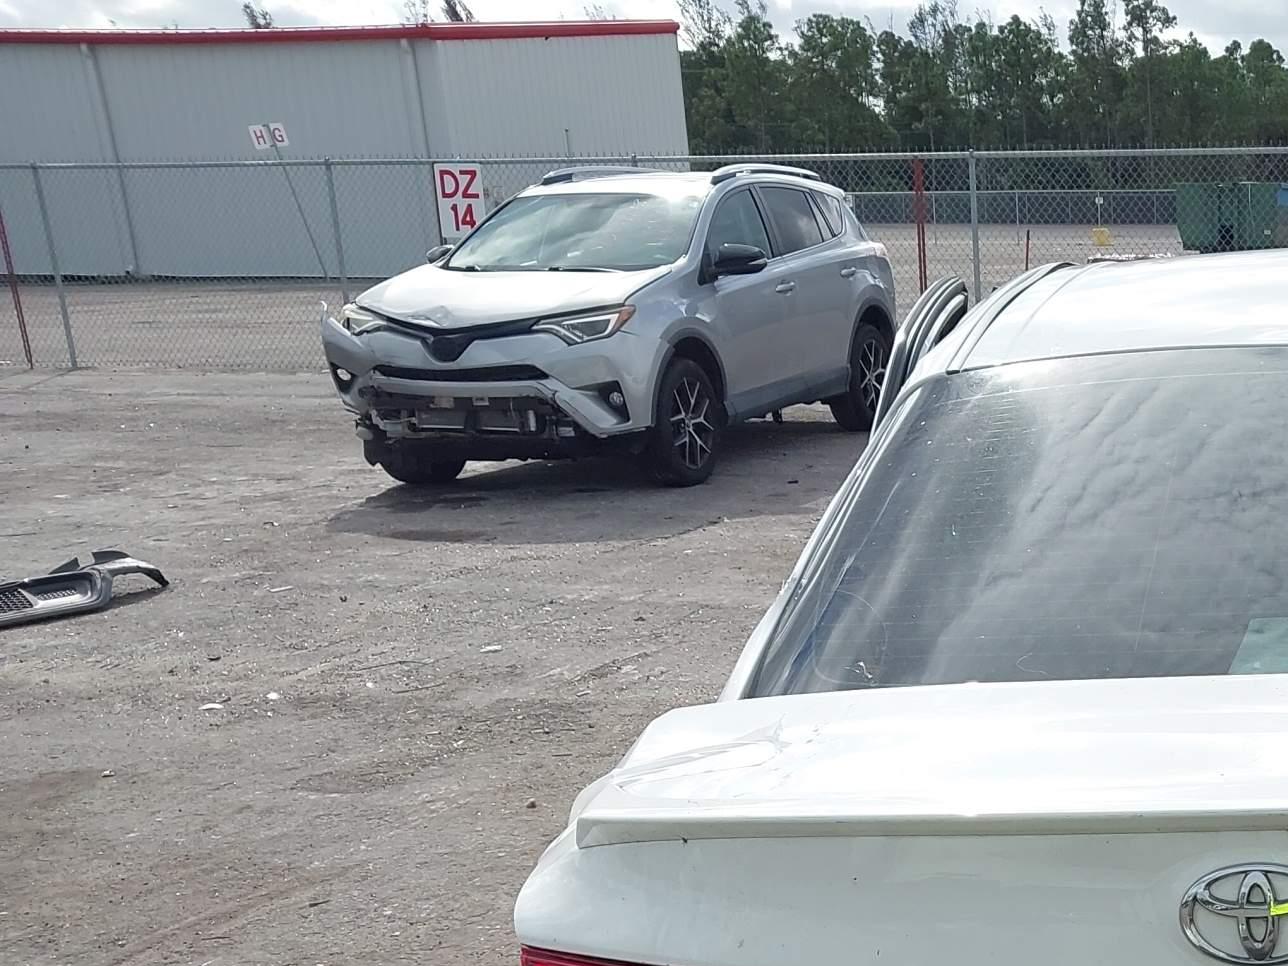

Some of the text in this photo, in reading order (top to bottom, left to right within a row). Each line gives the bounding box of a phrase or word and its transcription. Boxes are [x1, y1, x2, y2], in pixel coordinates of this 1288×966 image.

[253, 127, 285, 145] H G
[438, 169, 480, 199] DZ
[450, 203, 477, 232] 14
